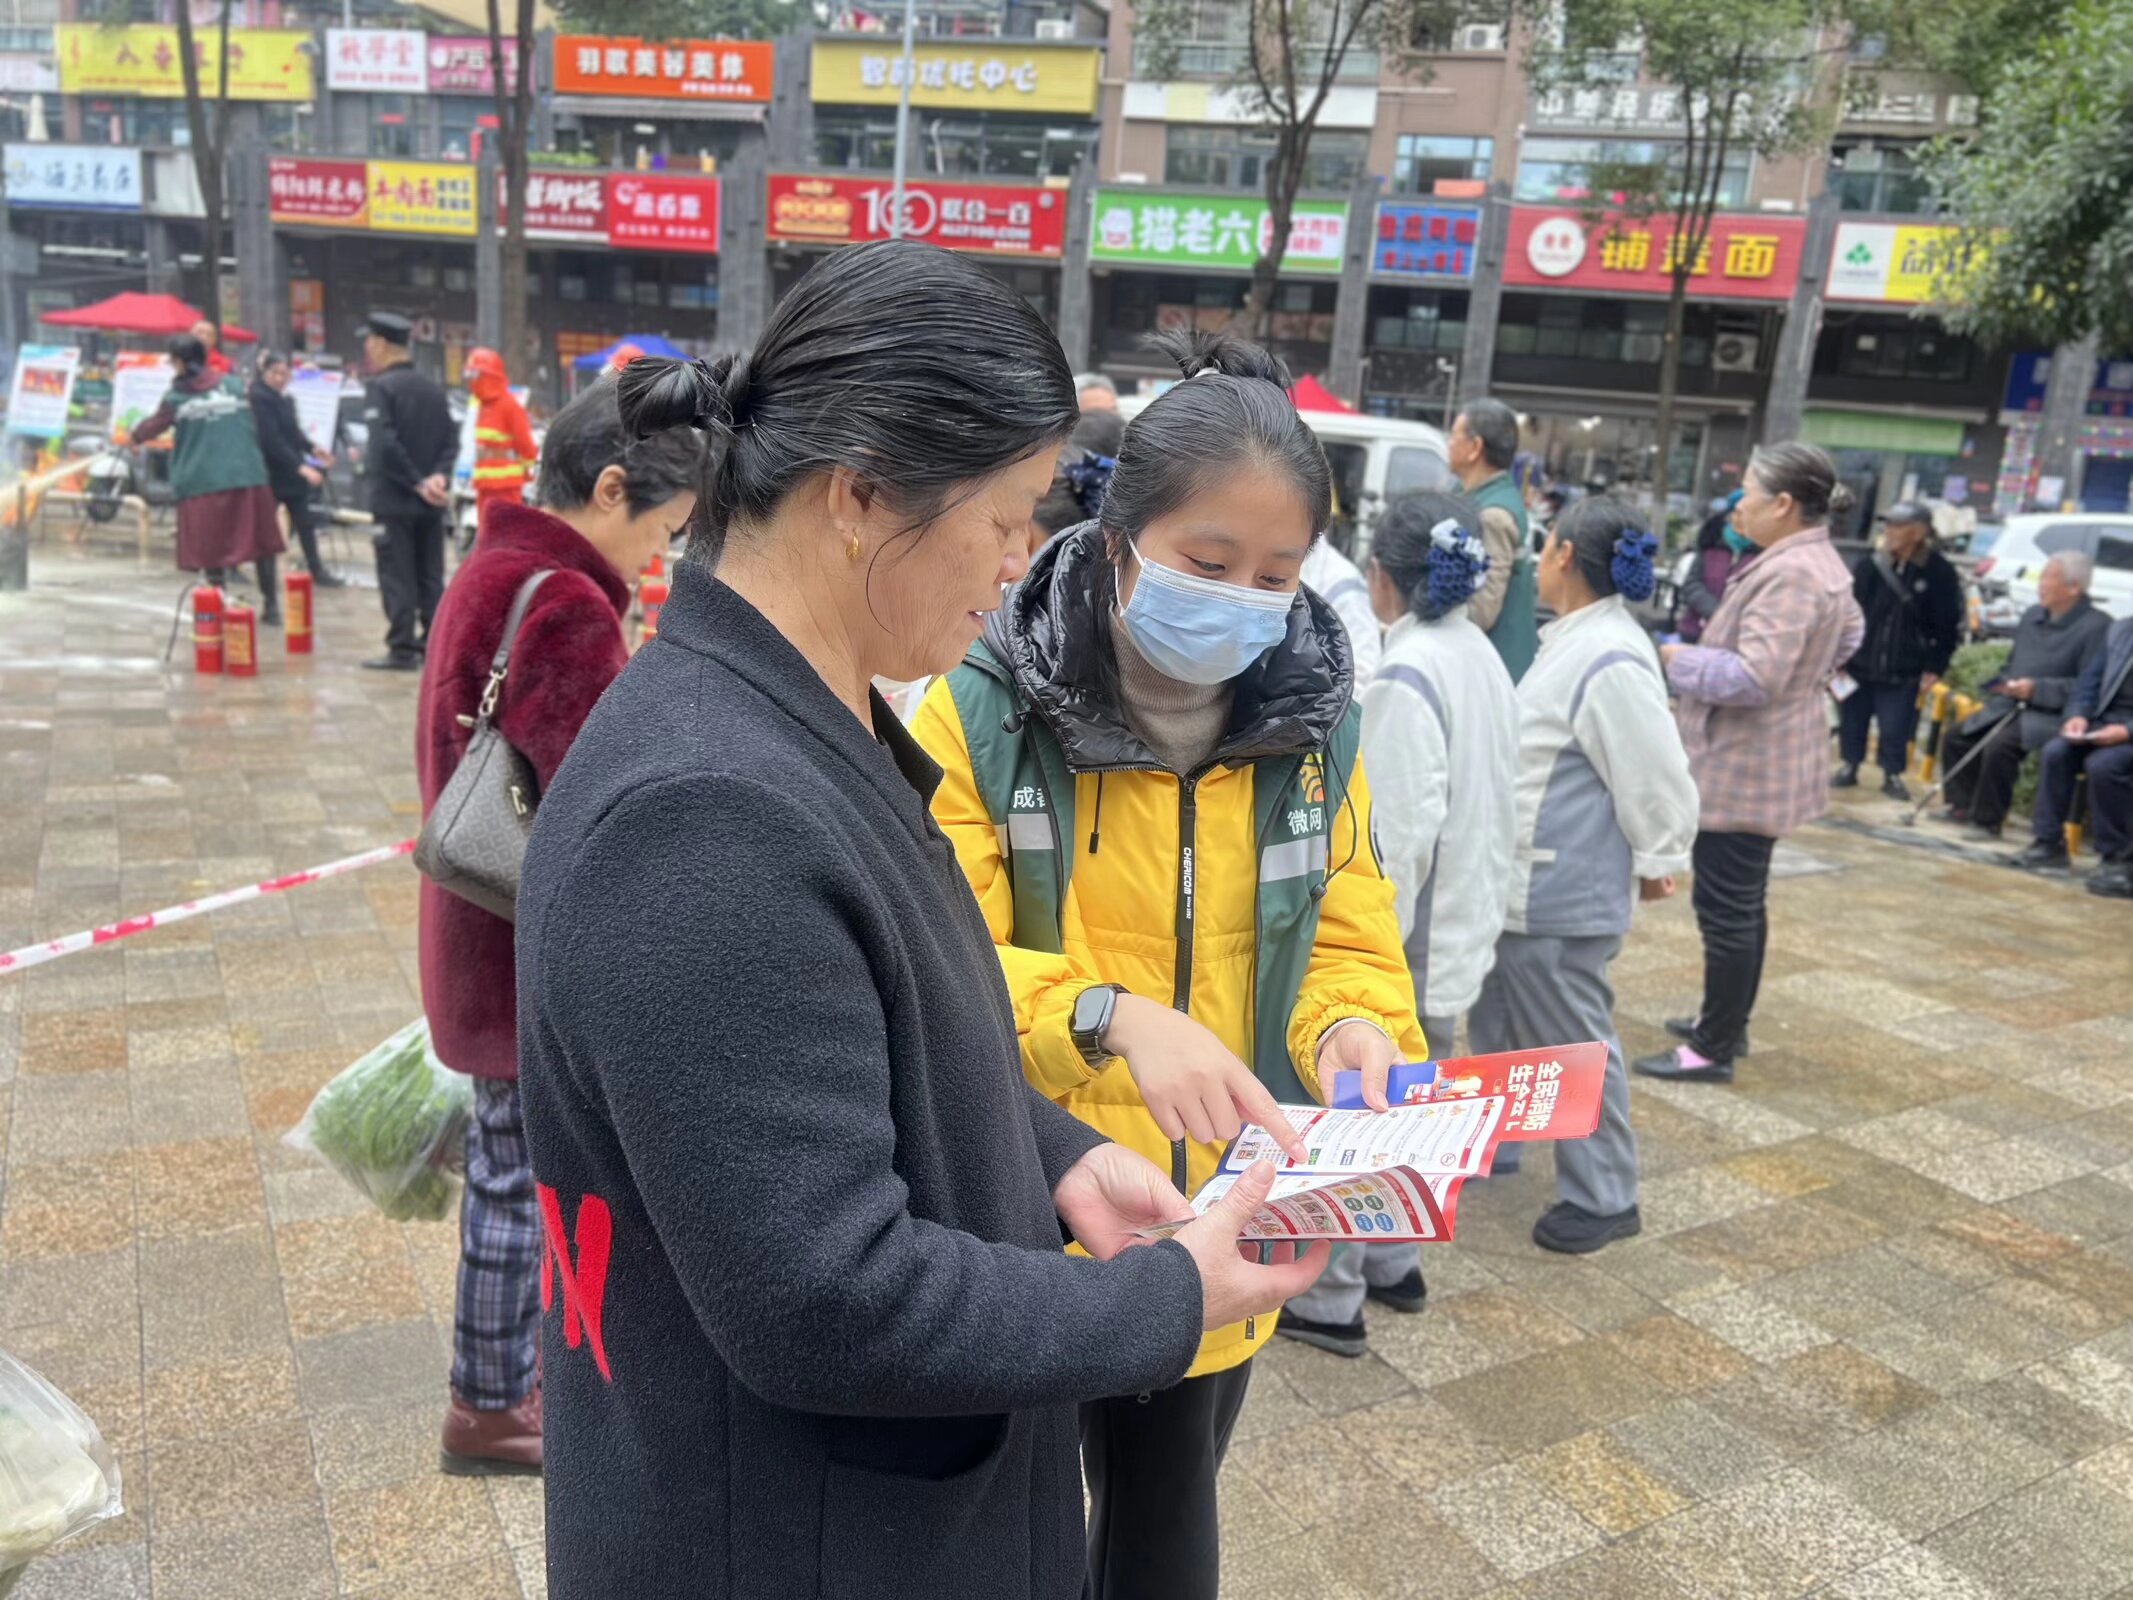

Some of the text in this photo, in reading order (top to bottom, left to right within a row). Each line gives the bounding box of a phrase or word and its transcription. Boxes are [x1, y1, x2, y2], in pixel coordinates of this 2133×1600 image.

[940, 197, 1031, 225] 联合一百
[1138, 202, 1252, 256] 猫老六
[1183, 847, 1192, 895] CHERICOM
[1520, 1060, 1564, 1131] 全民消防
